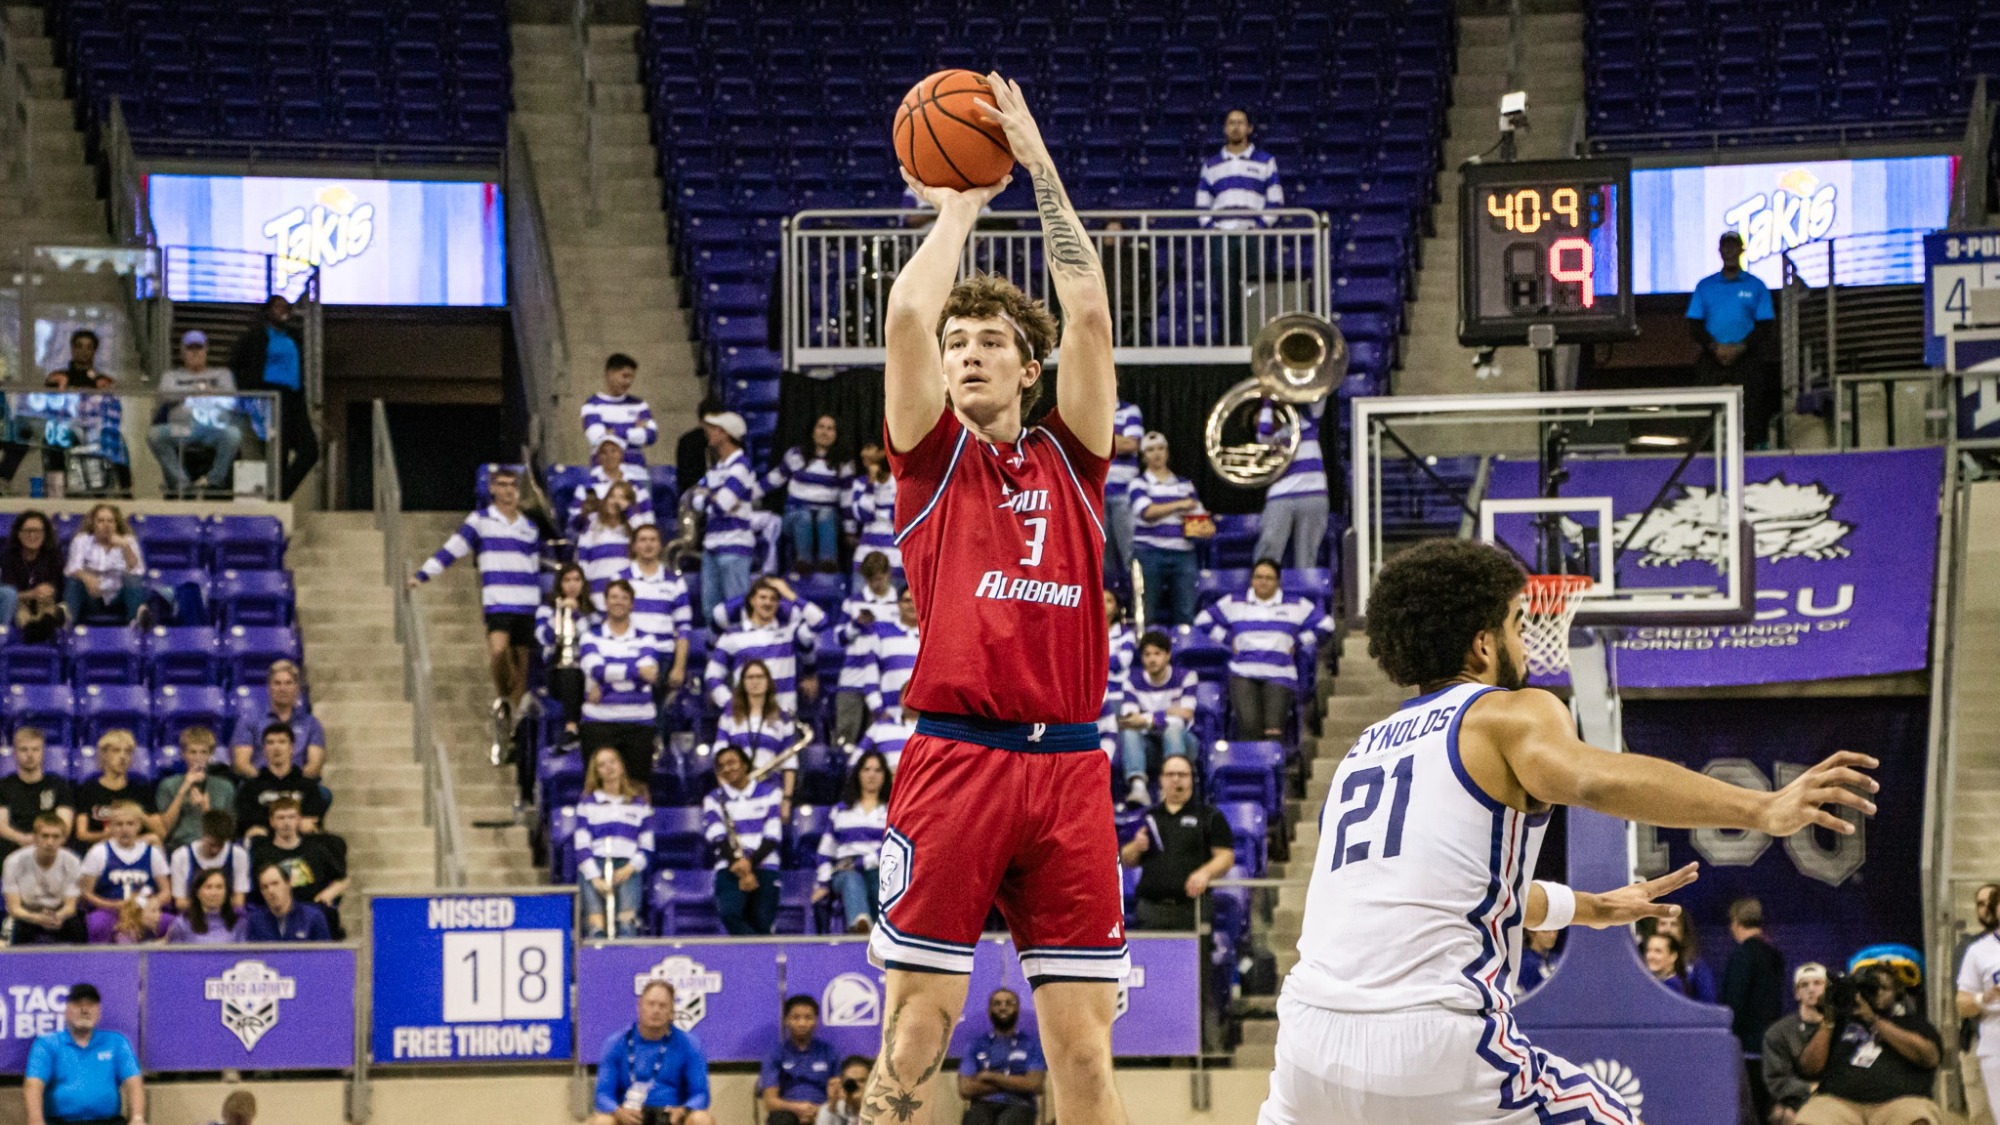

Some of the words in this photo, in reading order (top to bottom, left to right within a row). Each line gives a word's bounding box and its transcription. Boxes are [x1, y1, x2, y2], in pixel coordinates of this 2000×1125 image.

[1487, 187, 1578, 233] 40.9
[1549, 238, 1594, 308] 9
[1944, 276, 1971, 326] 4
[1020, 517, 1047, 567] 3
[975, 570, 1082, 608] ALABAMA
[1612, 639, 1714, 651] HORNED
[1637, 626, 1725, 640] CREDIT
[1729, 622, 1811, 638] UNION
[1816, 618, 1850, 632] OF
[1347, 706, 1457, 758] EYNOLDS
[1331, 754, 1415, 873] 21
[428, 898, 515, 929] MISSED
[8, 985, 69, 1014] TAC
[393, 1026, 452, 1058] FREE
[454, 1023, 552, 1056] THROWS
